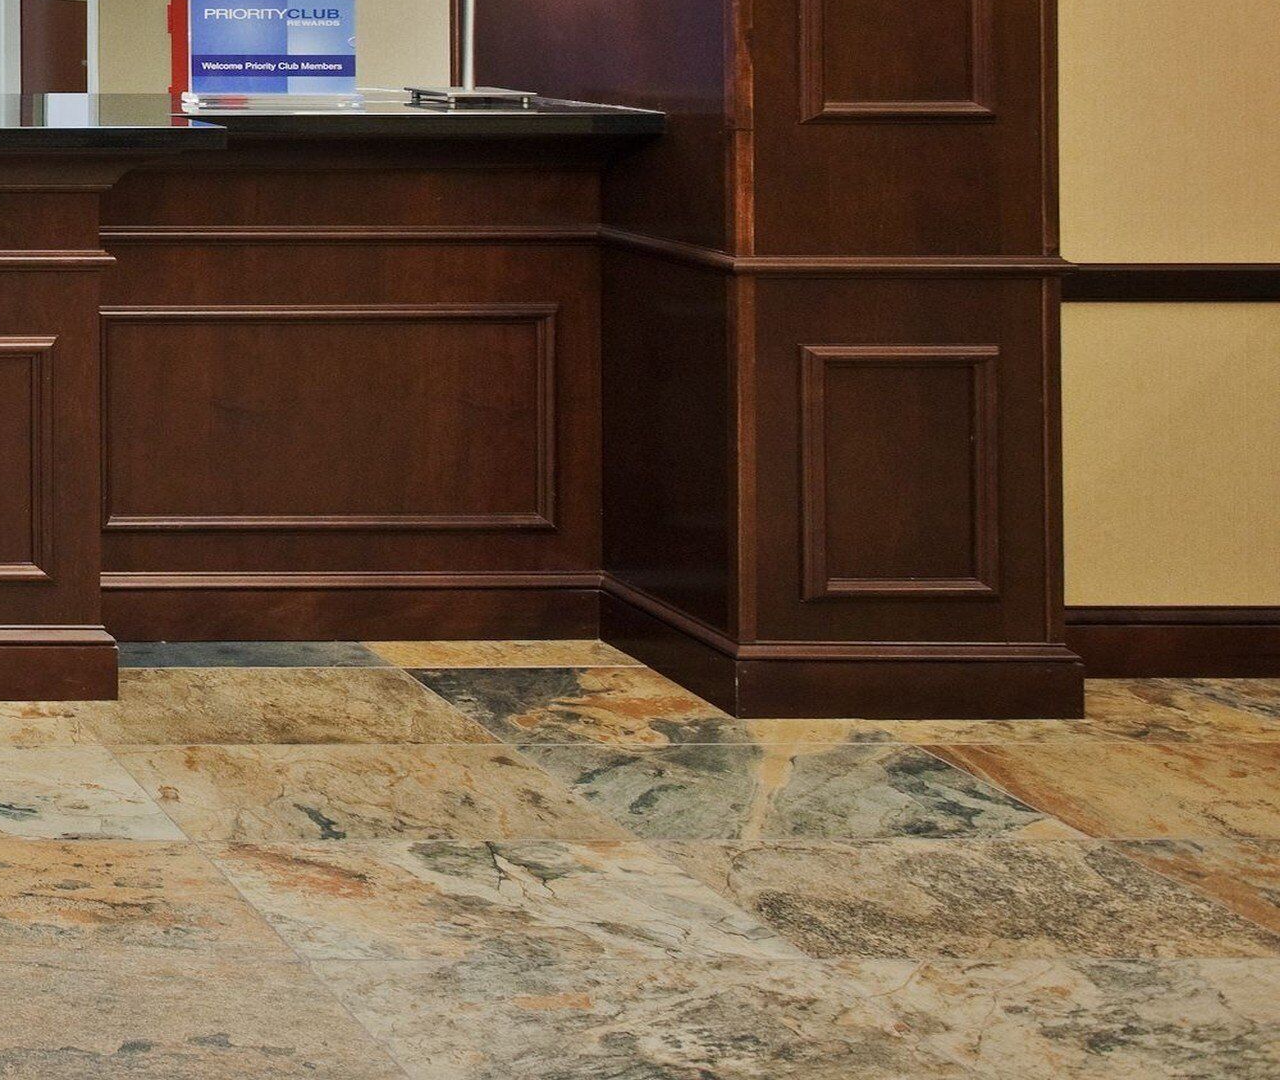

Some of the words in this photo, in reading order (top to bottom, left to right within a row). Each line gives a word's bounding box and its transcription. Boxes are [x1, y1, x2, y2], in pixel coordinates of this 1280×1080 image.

[286, 19, 341, 27] REWARDS
[201, 61, 243, 71] Welcome
[244, 61, 277, 72] Priority
[278, 61, 299, 71] Club
[300, 61, 343, 71] Members
